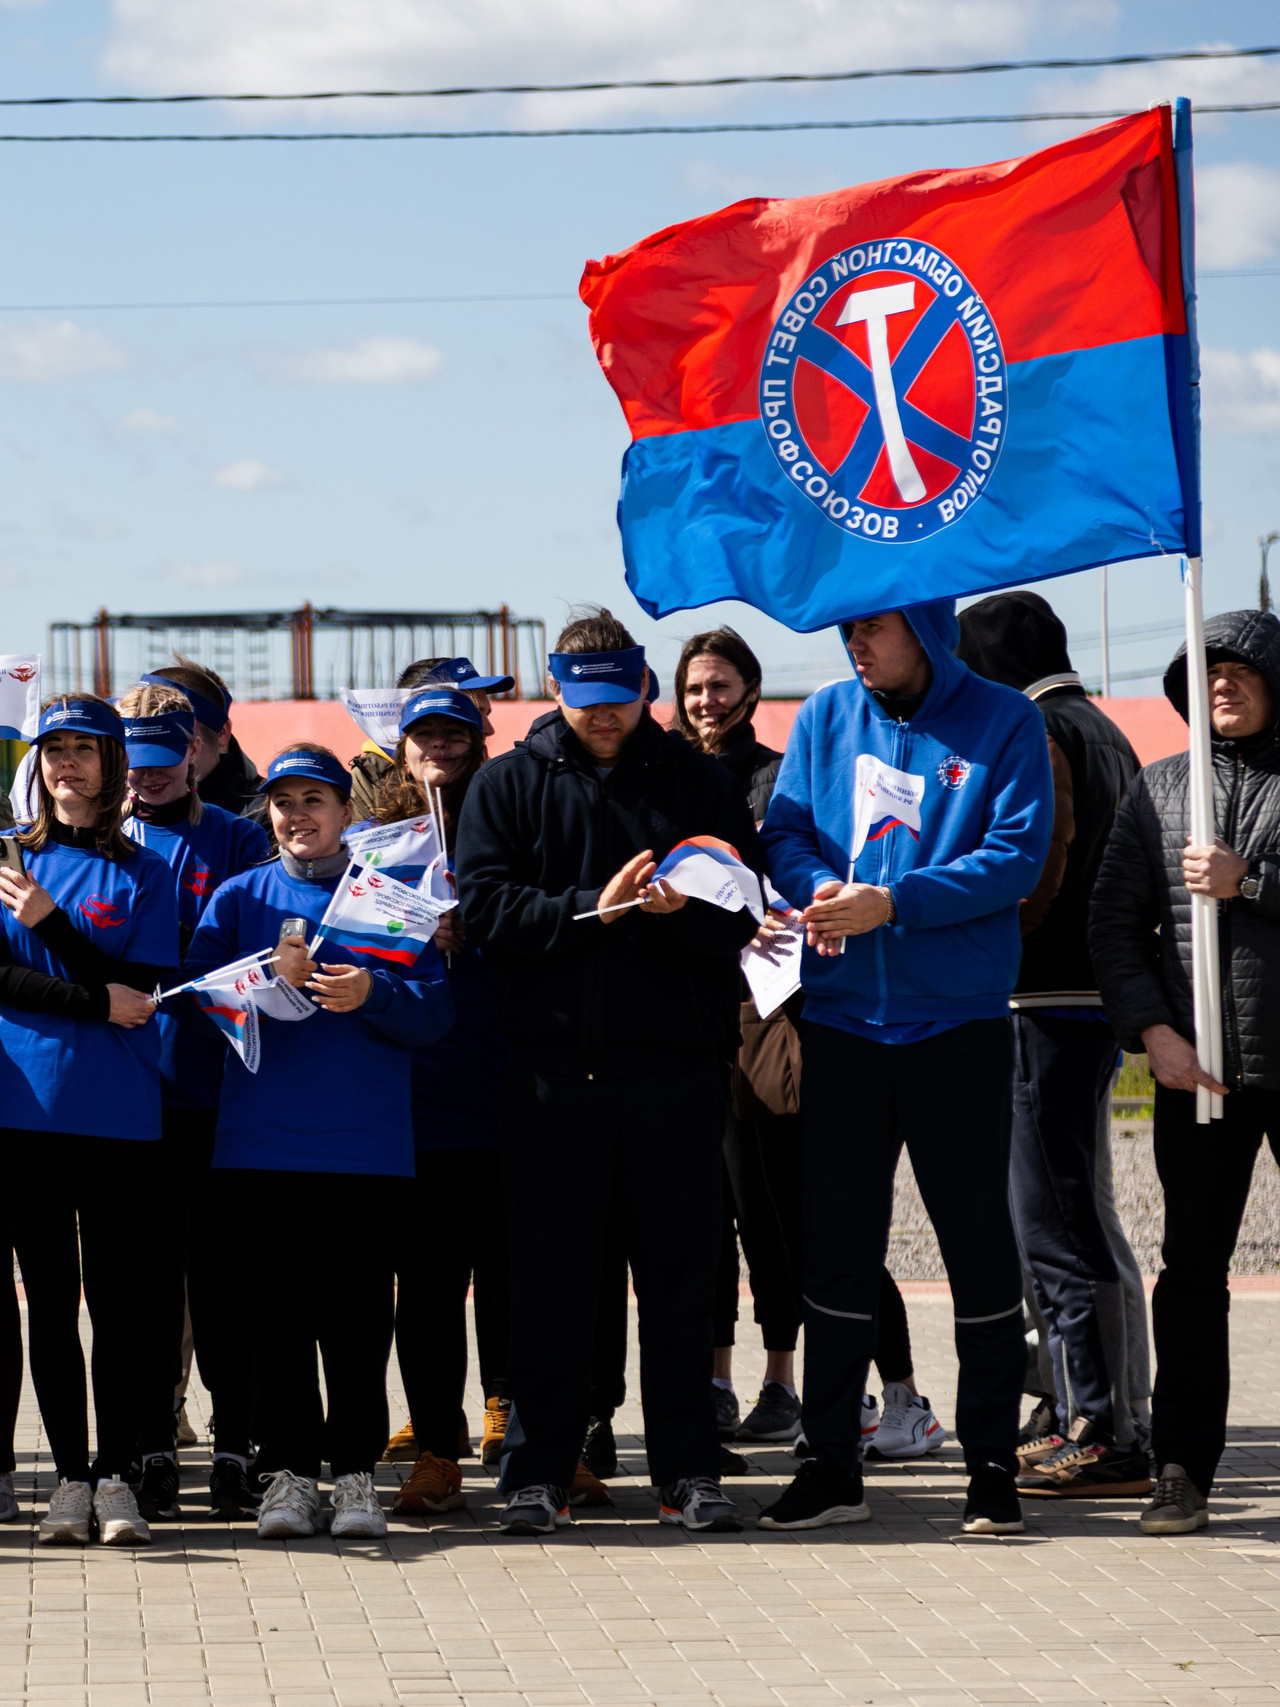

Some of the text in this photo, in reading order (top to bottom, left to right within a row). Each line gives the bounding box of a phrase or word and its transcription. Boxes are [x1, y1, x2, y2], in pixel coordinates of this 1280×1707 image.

[374, 891, 405, 907] ПРОФСОЮЗ
[391, 884, 421, 901] ПРОФСОЮЗ
[246, 1000, 256, 1034] ПРОФСОЮЗ
